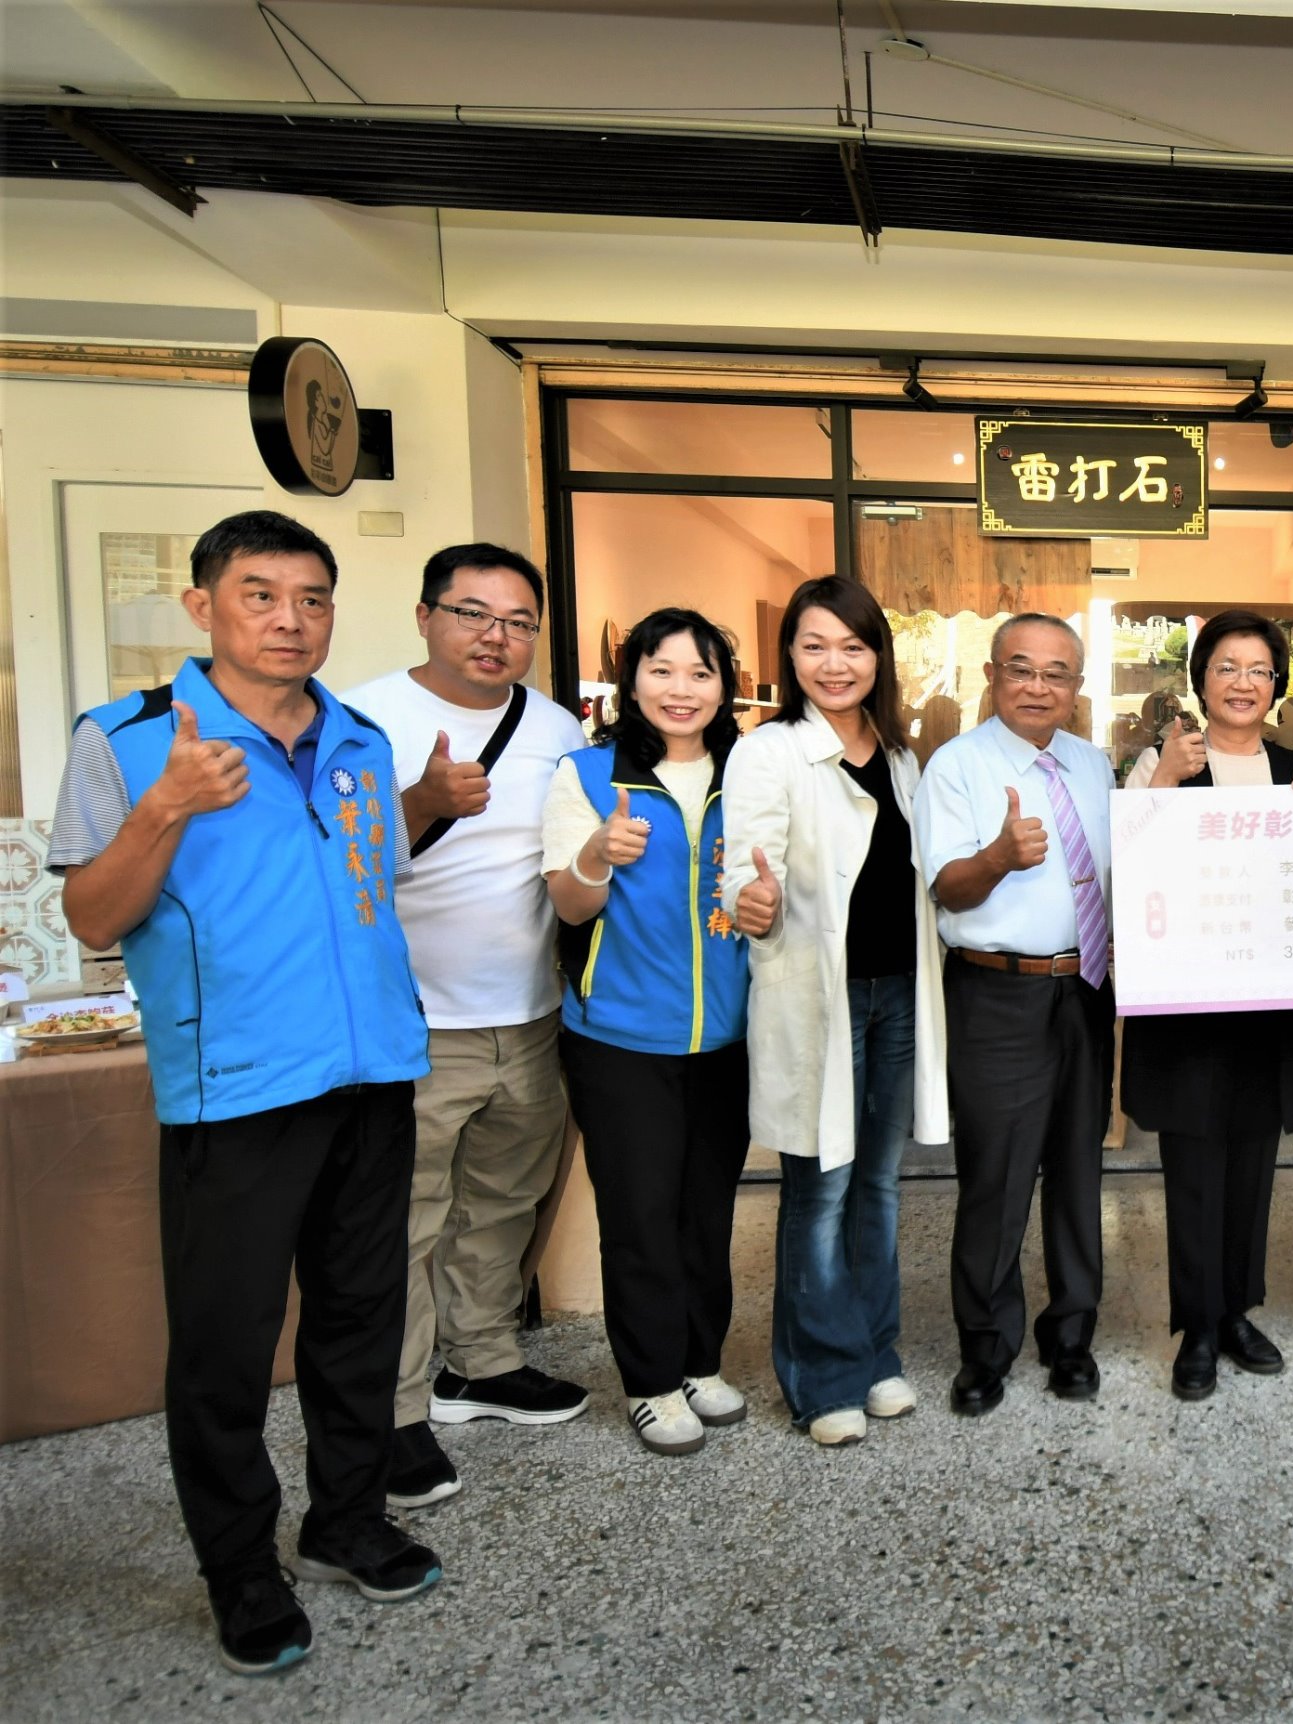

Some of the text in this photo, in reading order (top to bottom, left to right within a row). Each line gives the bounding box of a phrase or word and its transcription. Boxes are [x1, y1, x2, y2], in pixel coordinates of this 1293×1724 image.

[1010, 452, 1168, 504] 雷打石
[1226, 948, 1255, 961] NT$
